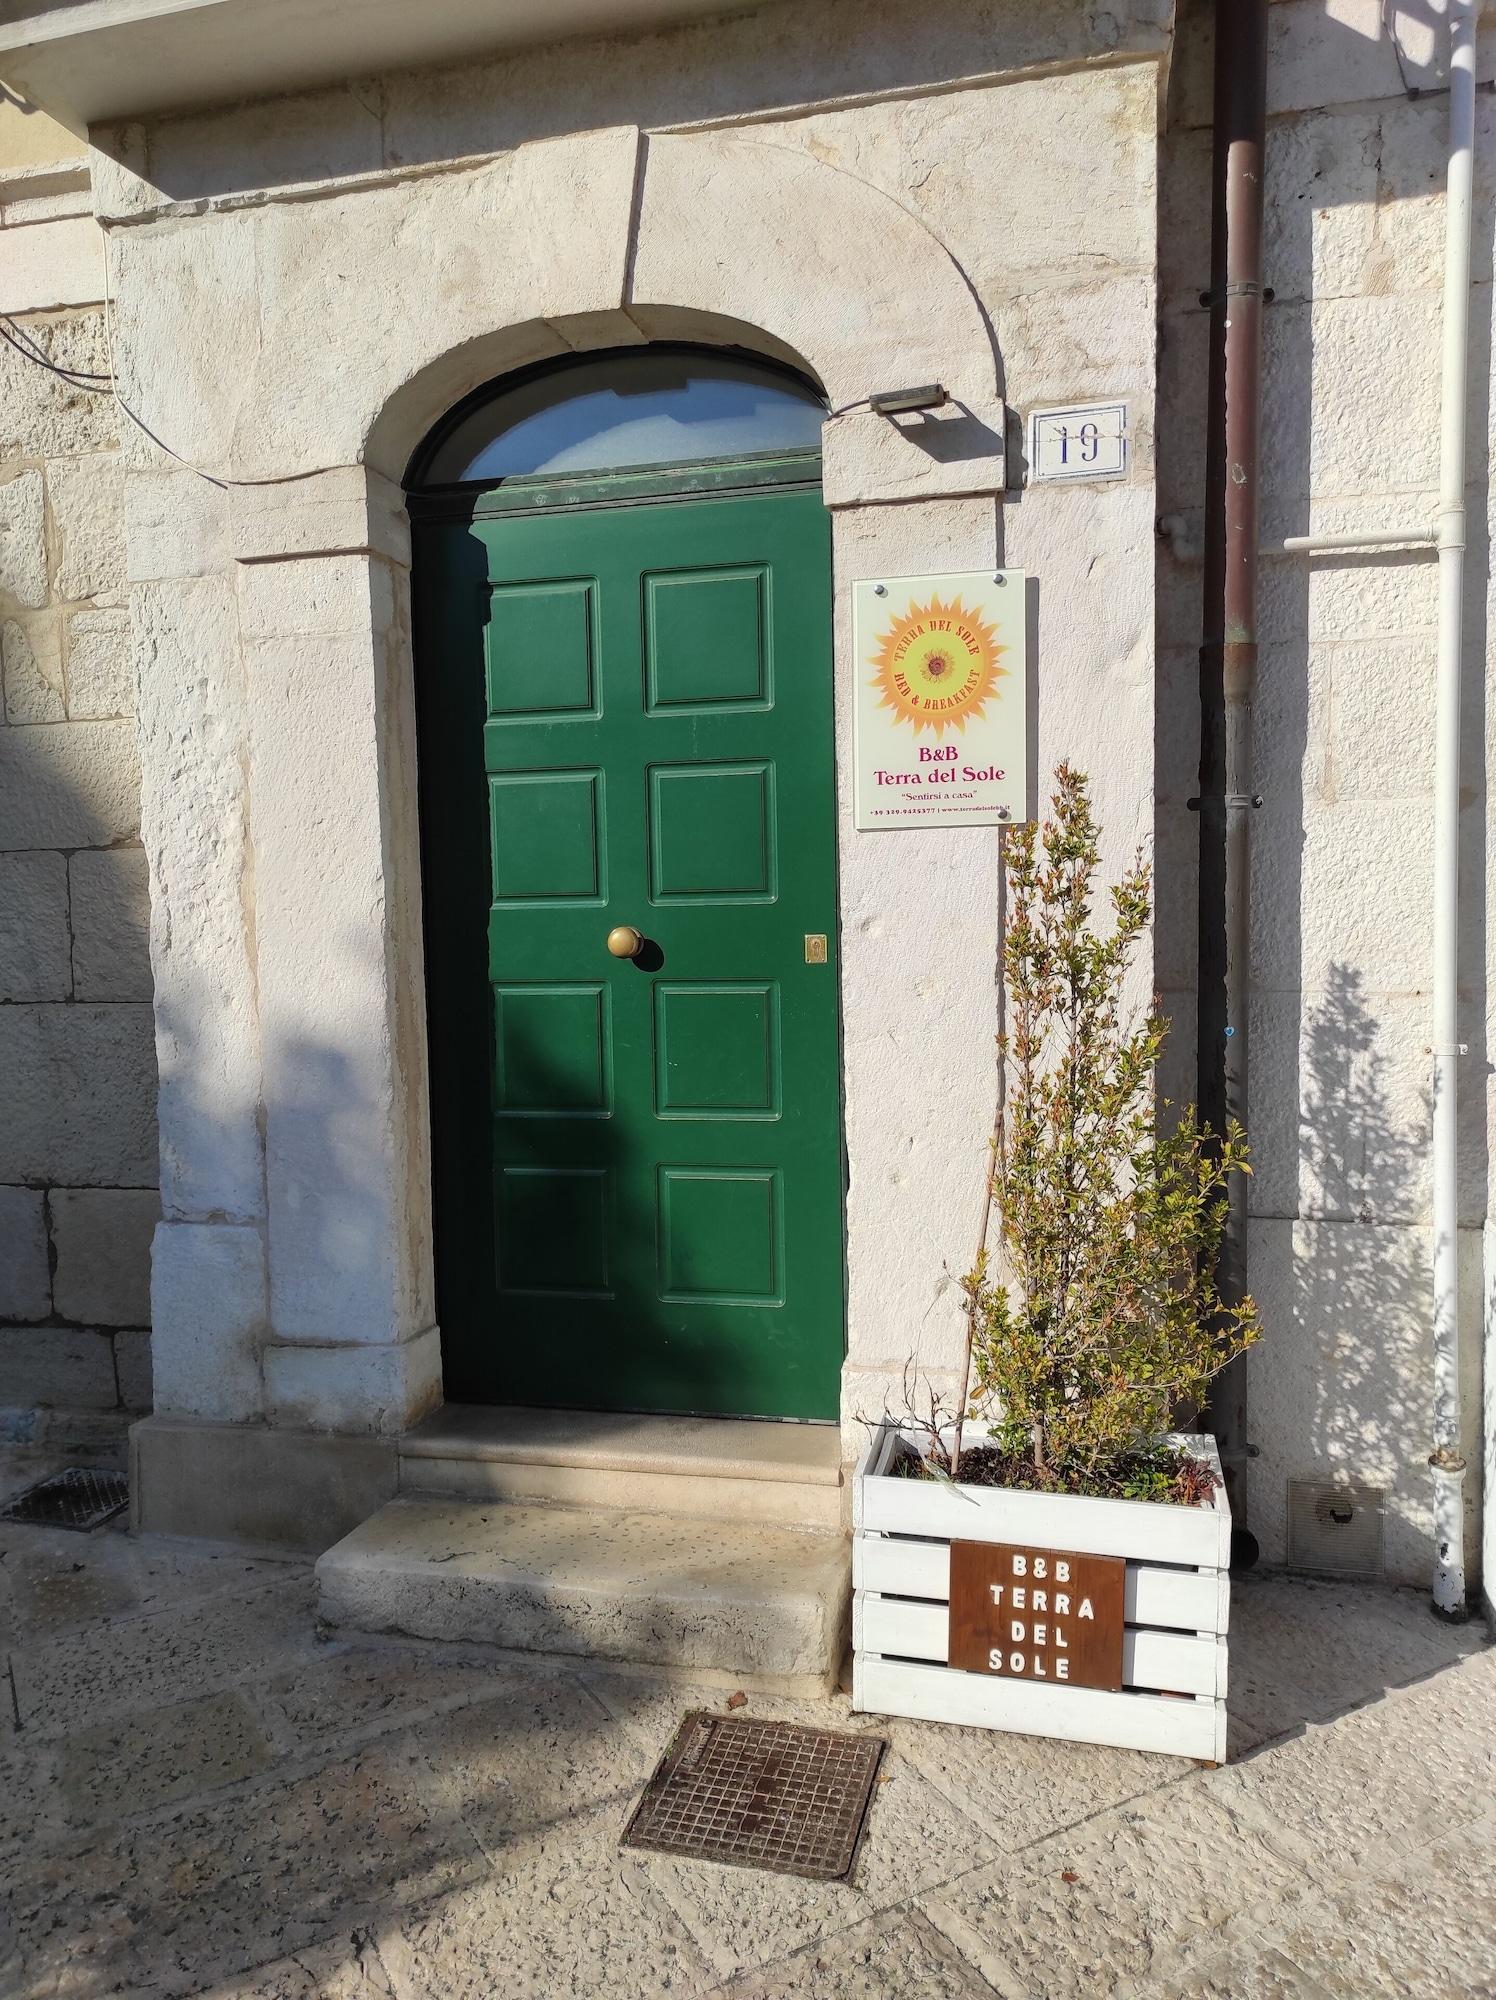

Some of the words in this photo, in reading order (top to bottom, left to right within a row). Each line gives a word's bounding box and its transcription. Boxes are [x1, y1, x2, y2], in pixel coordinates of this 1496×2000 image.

[1060, 424, 1098, 464] 19
[893, 624, 925, 662] TERRA
[929, 619, 953, 632] DEL
[955, 625, 980, 656] SOLE
[894, 672, 911, 697] BED
[911, 694, 920, 706] &
[922, 669, 980, 710] BREAKFAST
[919, 746, 959, 762] B&B
[873, 770, 922, 786] Terra
[928, 768, 956, 783] del
[962, 766, 1006, 782] Sole
[1012, 1555, 1071, 1583] B&B
[990, 1584, 1095, 1620] TERRA
[1011, 1620, 1068, 1648] DEL
[988, 1649, 1069, 1679] SOLE
